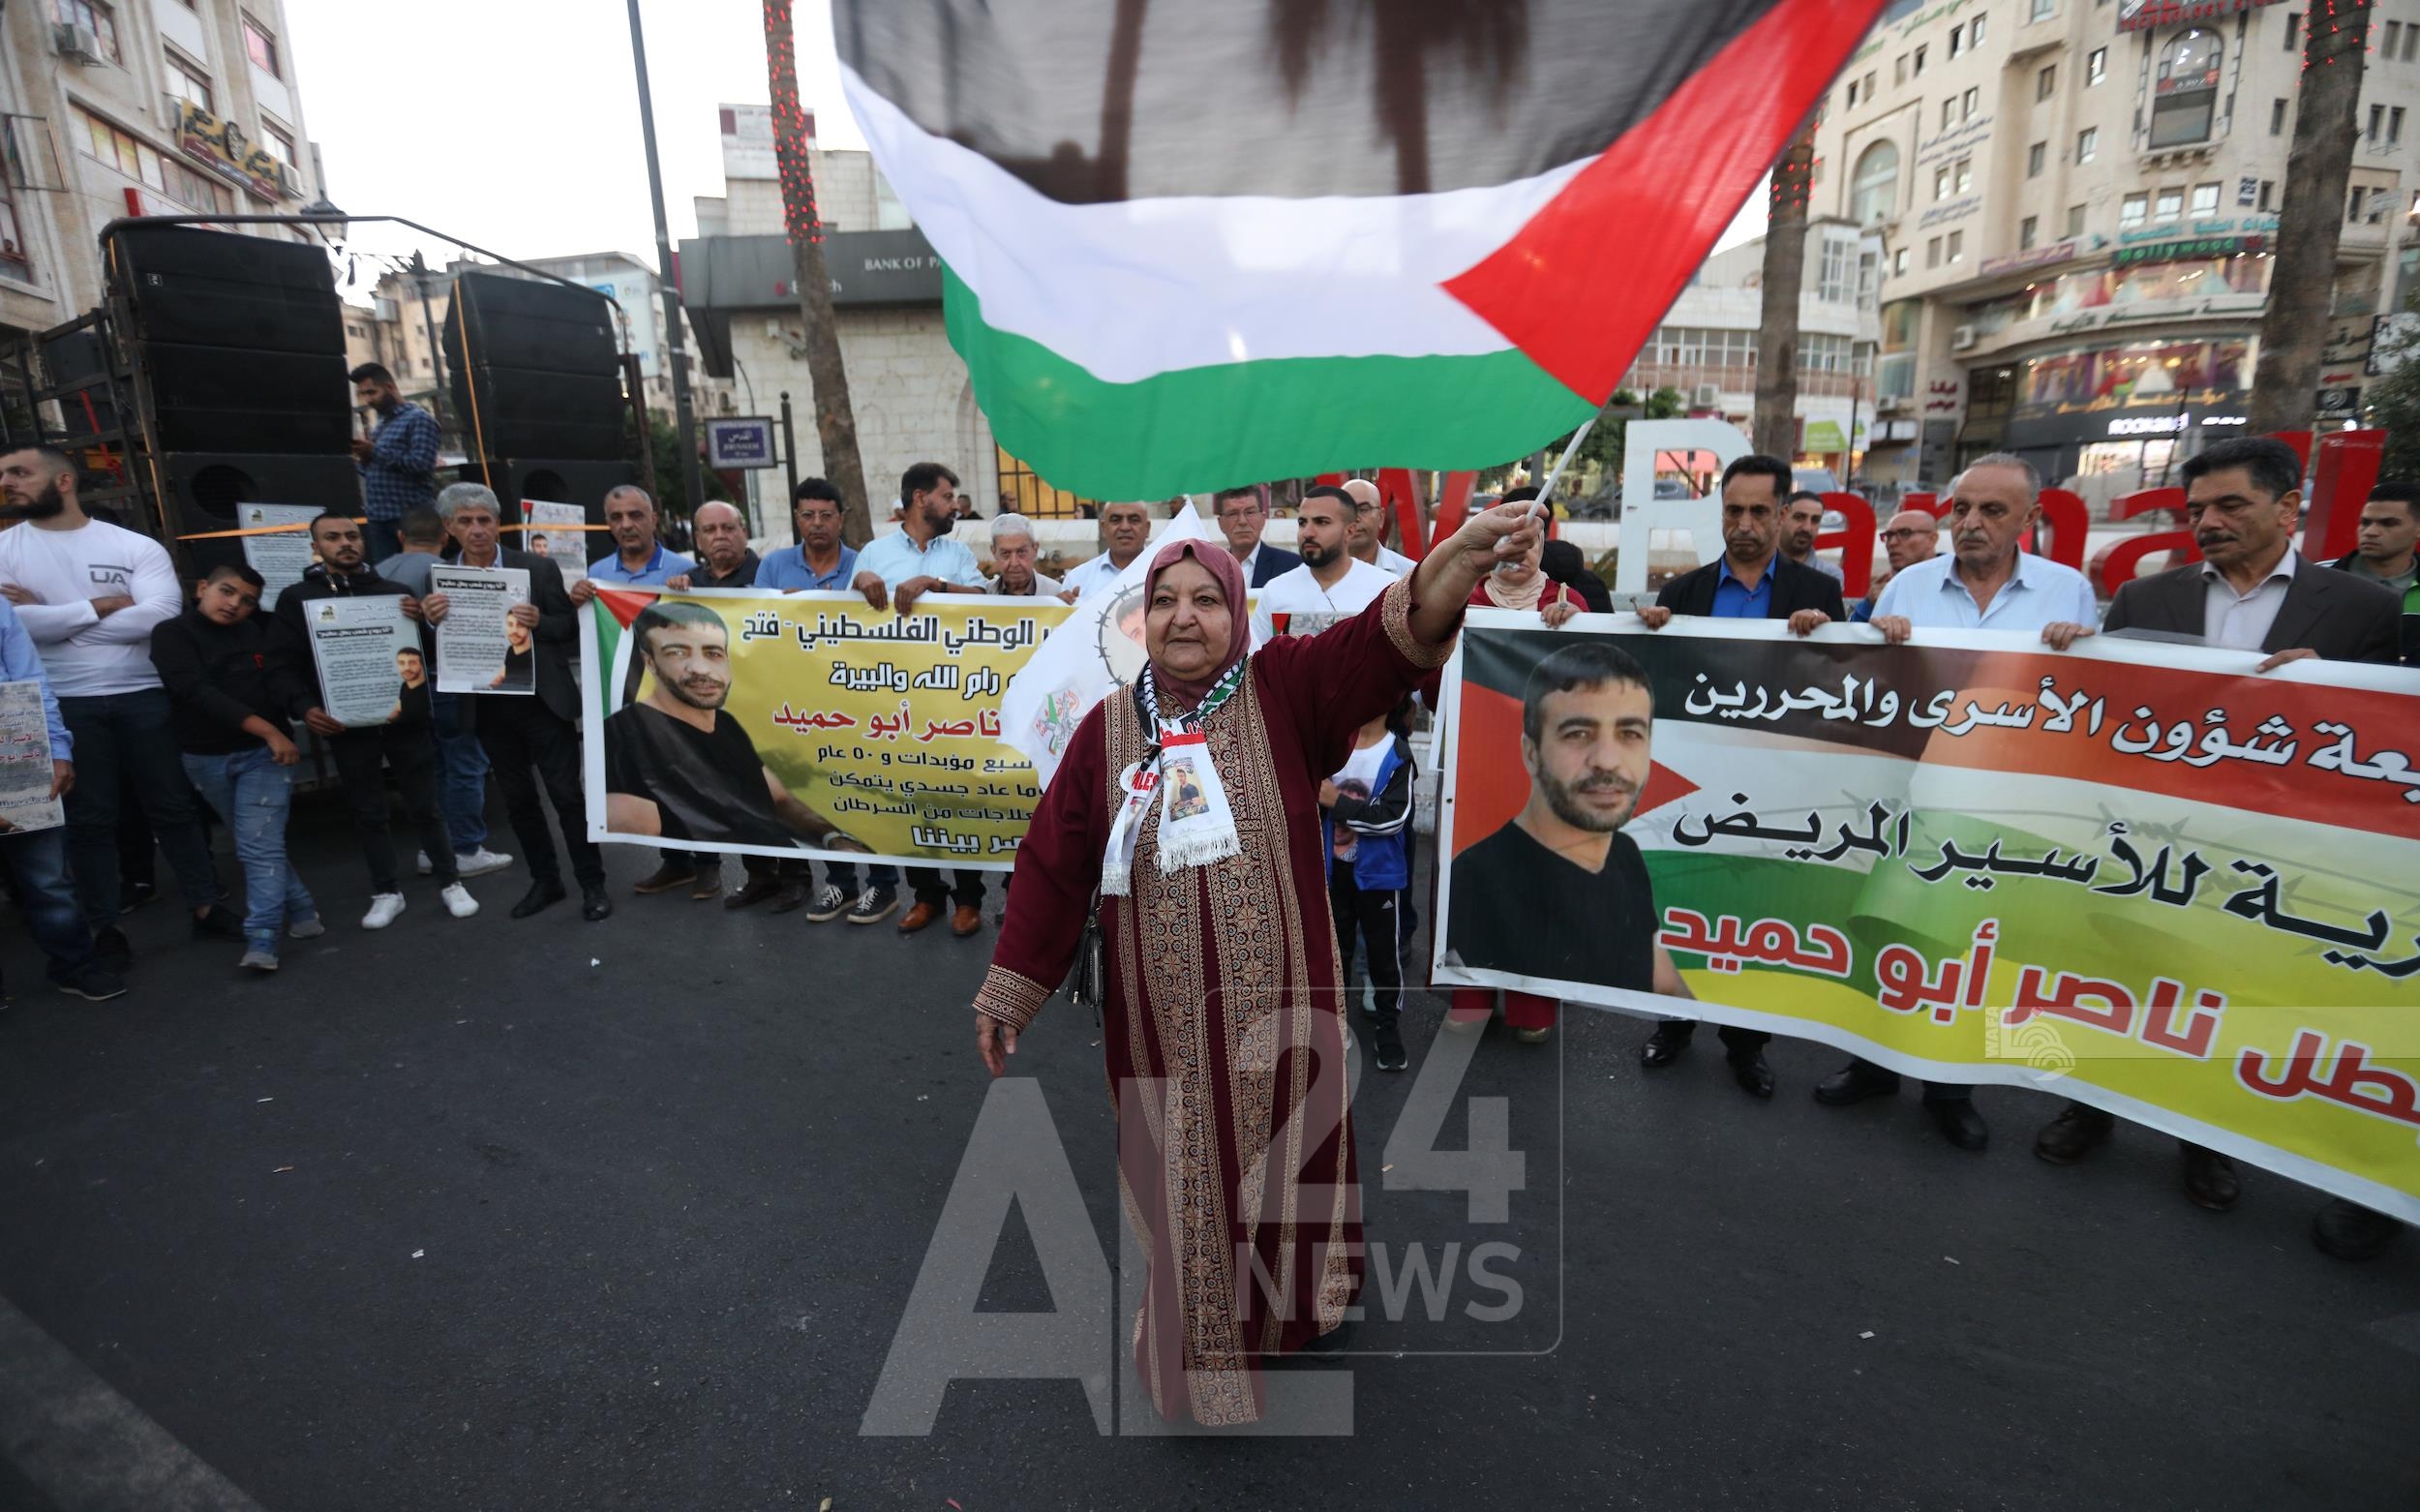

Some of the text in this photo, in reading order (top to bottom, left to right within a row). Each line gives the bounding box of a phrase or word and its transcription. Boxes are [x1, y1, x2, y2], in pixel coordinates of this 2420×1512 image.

[864, 258, 902, 271] BANK
[904, 257, 923, 269] OF
[742, 614, 778, 640] فتح
[799, 615, 937, 649] الفلسطيني
[944, 619, 1033, 654] الوطني
[830, 662, 908, 691] والبيرة
[914, 665, 958, 689] الله
[963, 666, 1000, 700] رام
[1685, 673, 1899, 726] والمحررين
[1908, 676, 2104, 736] الأسرى
[774, 705, 855, 733] حميد
[871, 701, 910, 741] أبو
[918, 710, 1001, 741] ناصر
[2111, 707, 2298, 766] شؤون
[818, 744, 846, 763] عام
[882, 753, 891, 765] و
[898, 754, 974, 771] مؤبدات
[830, 771, 892, 790] يتمكن
[900, 782, 969, 798] جسدي
[977, 783, 1010, 796] عاد
[834, 797, 917, 815] السرطان
[923, 803, 951, 819] من
[912, 826, 980, 853] بيننا
[1673, 793, 2420, 976] رية للأسير المريض
[1659, 906, 1852, 975] حميد
[1876, 918, 1999, 1025] أبو
[2002, 965, 2225, 1060] ناصر
